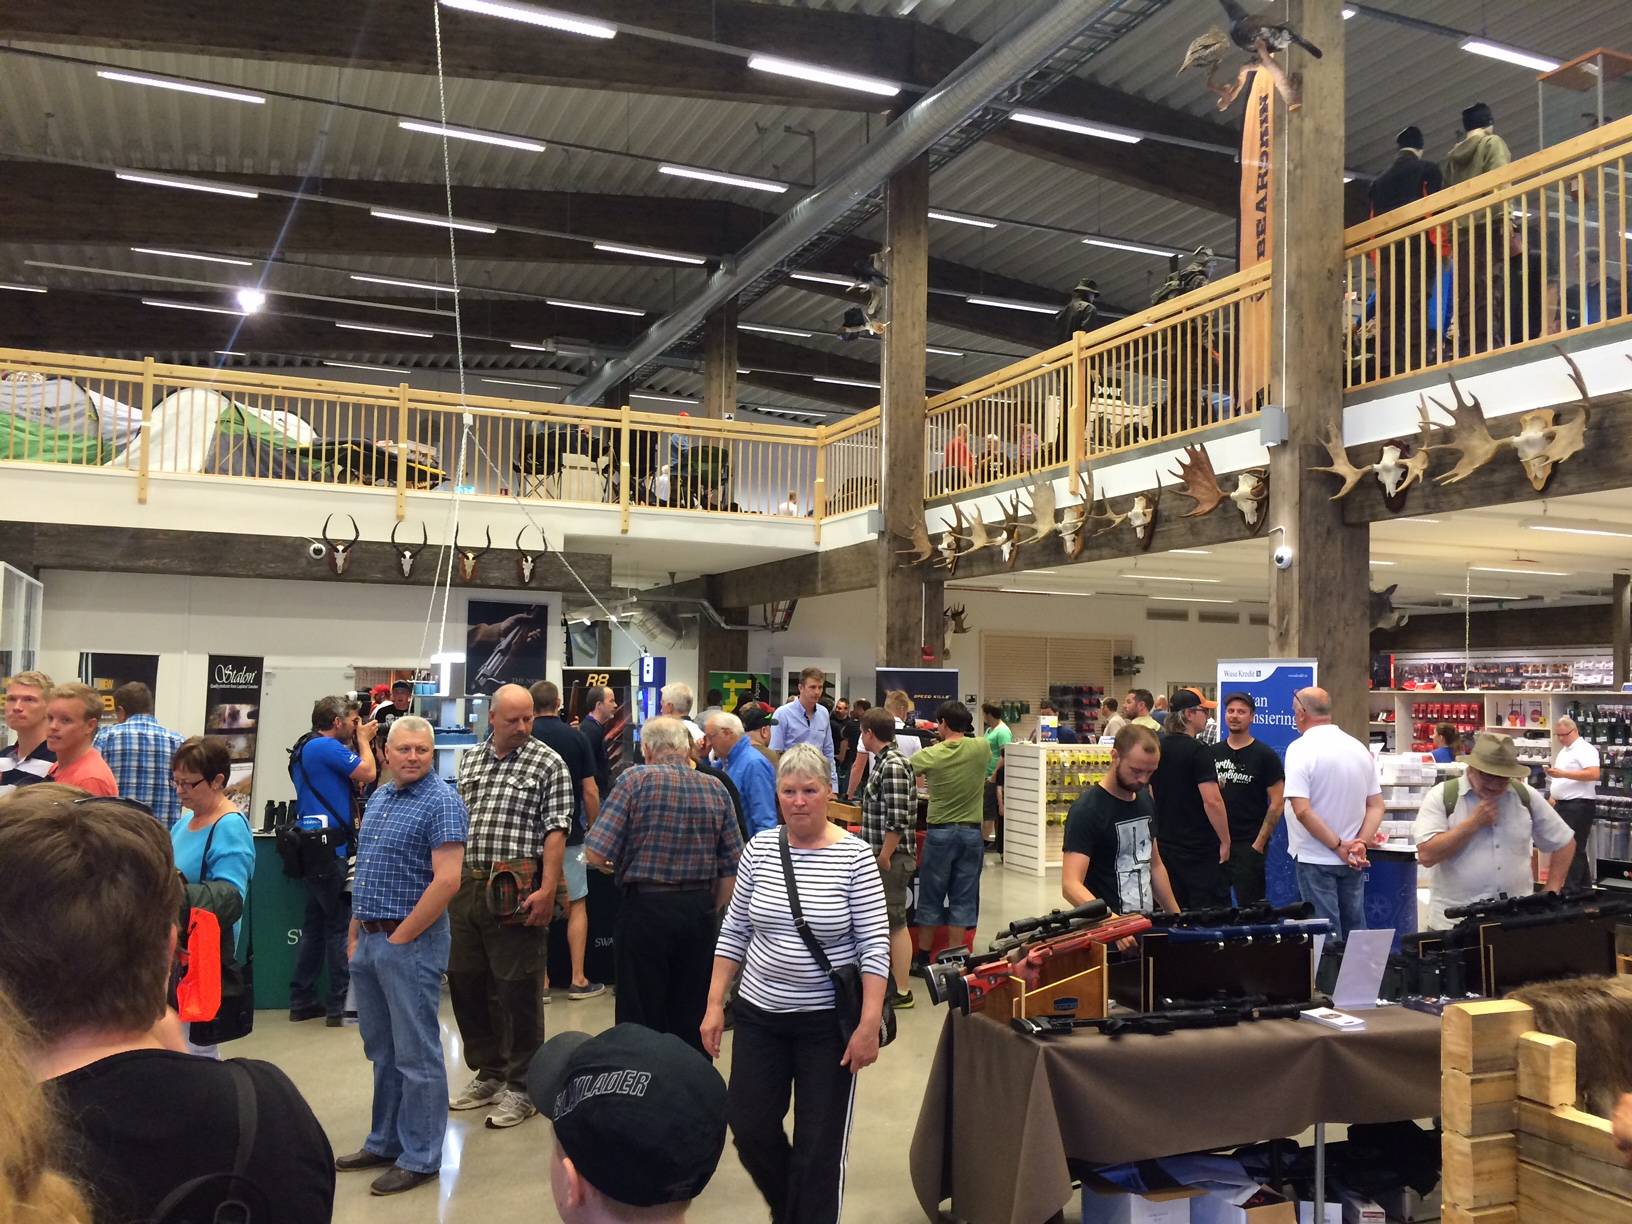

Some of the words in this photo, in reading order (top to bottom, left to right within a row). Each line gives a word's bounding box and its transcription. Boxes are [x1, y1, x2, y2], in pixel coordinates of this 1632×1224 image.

[1255, 93, 1270, 262] BEARSKIN
[214, 664, 258, 684] Stalon
[585, 673, 610, 687] R8
[1223, 669, 1238, 678] Wasa
[1239, 669, 1255, 678] Kredit
[1248, 691, 1268, 708] an
[1252, 709, 1298, 730] nsiering
